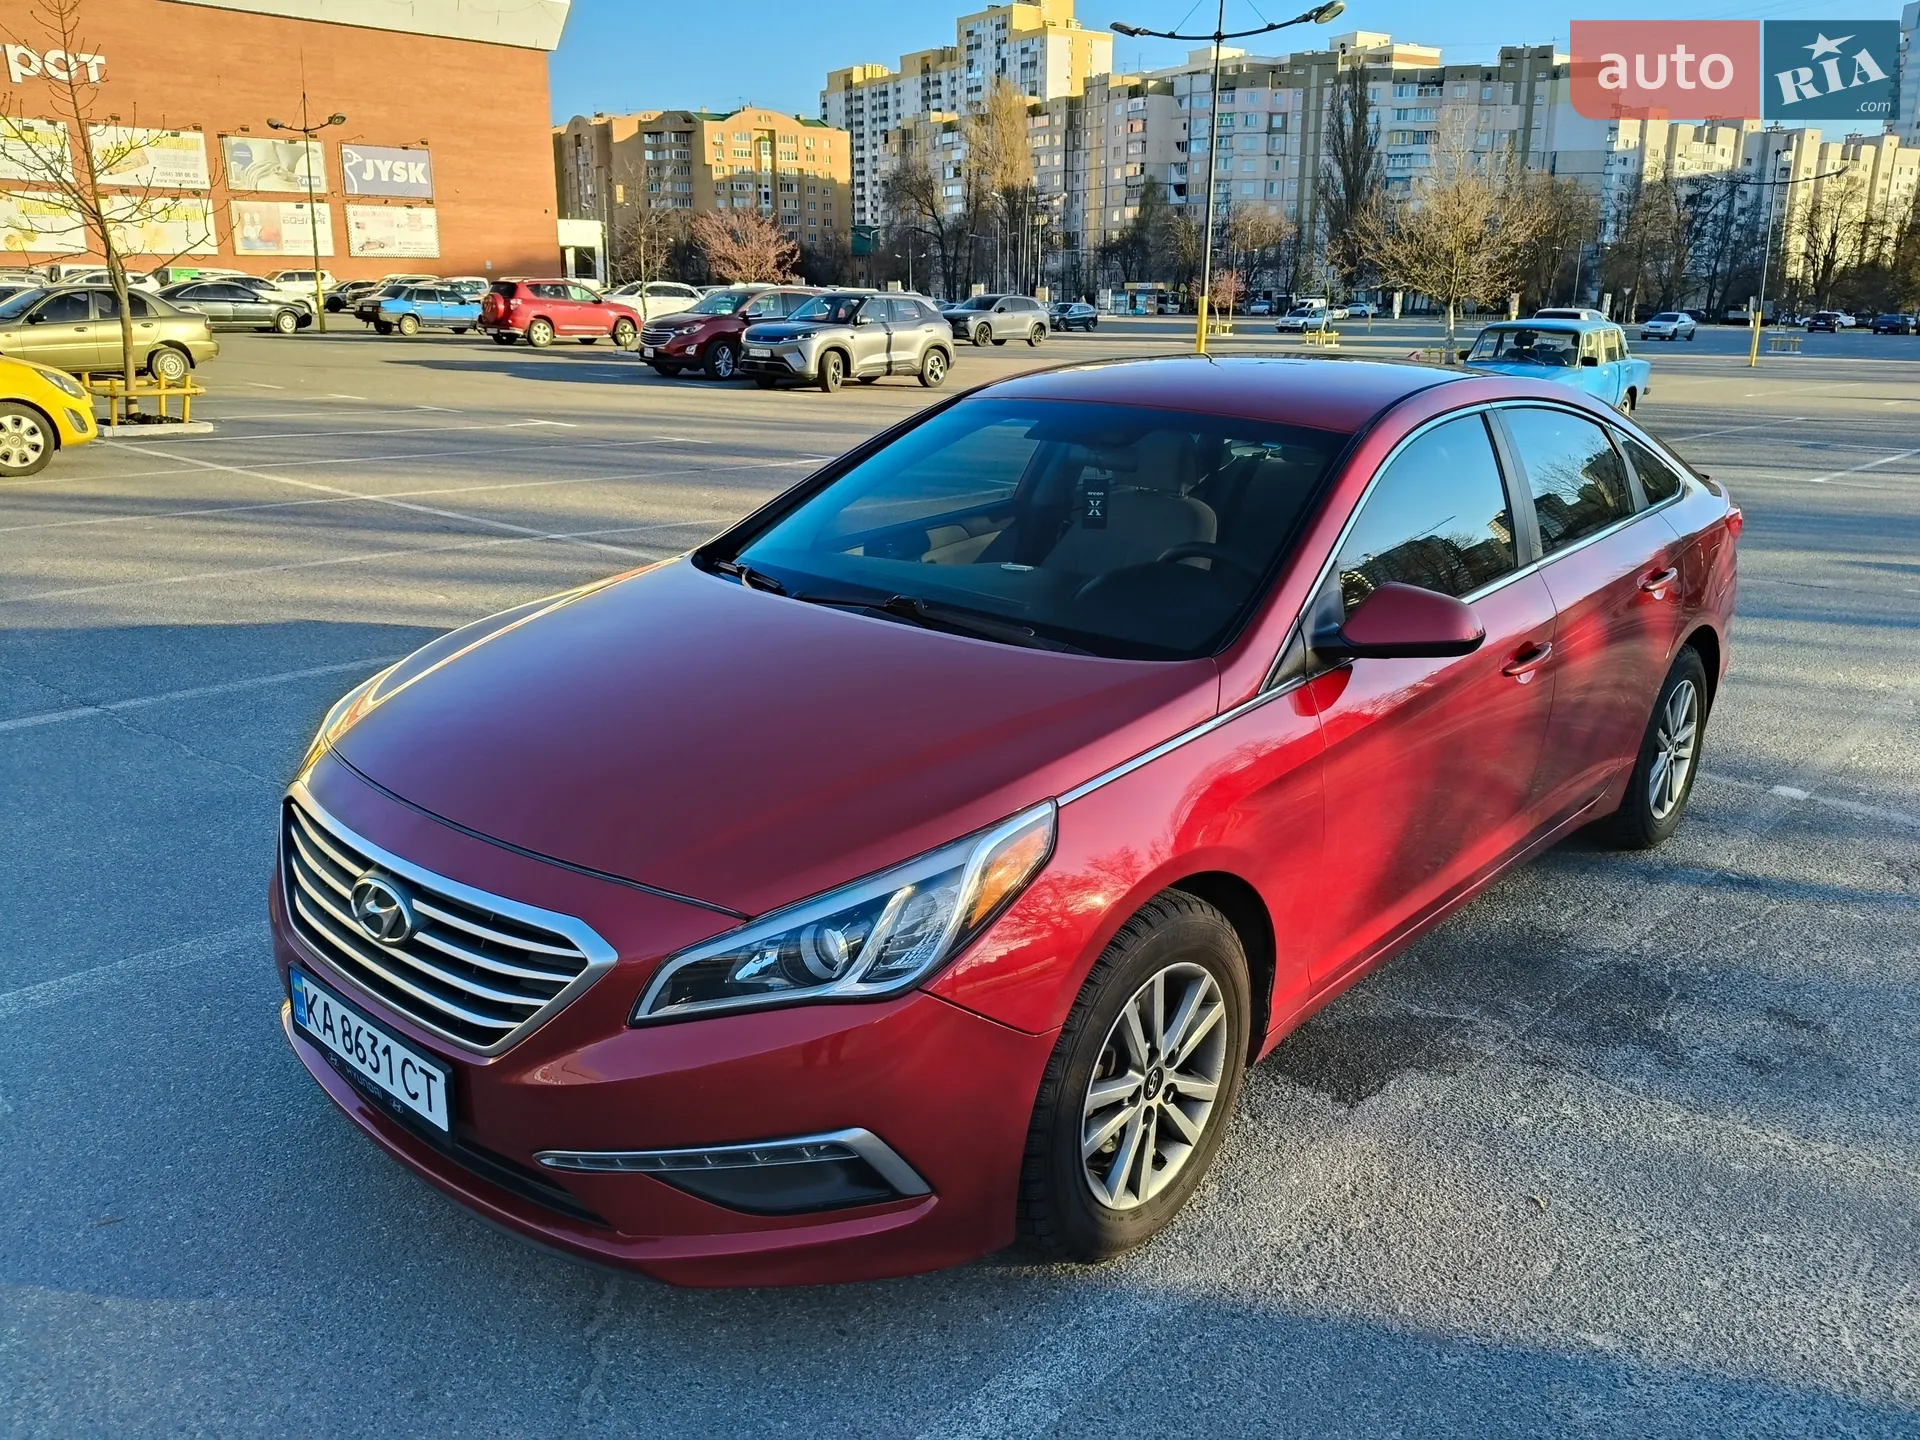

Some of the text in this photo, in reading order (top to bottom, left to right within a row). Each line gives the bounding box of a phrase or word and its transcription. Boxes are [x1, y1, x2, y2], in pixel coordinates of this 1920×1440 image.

[361, 158, 428, 185] JYSK
[296, 1005, 306, 1018] UA
[304, 986, 438, 1113] KA 8631 CT
[345, 1064, 383, 1099] HYUNDAI
